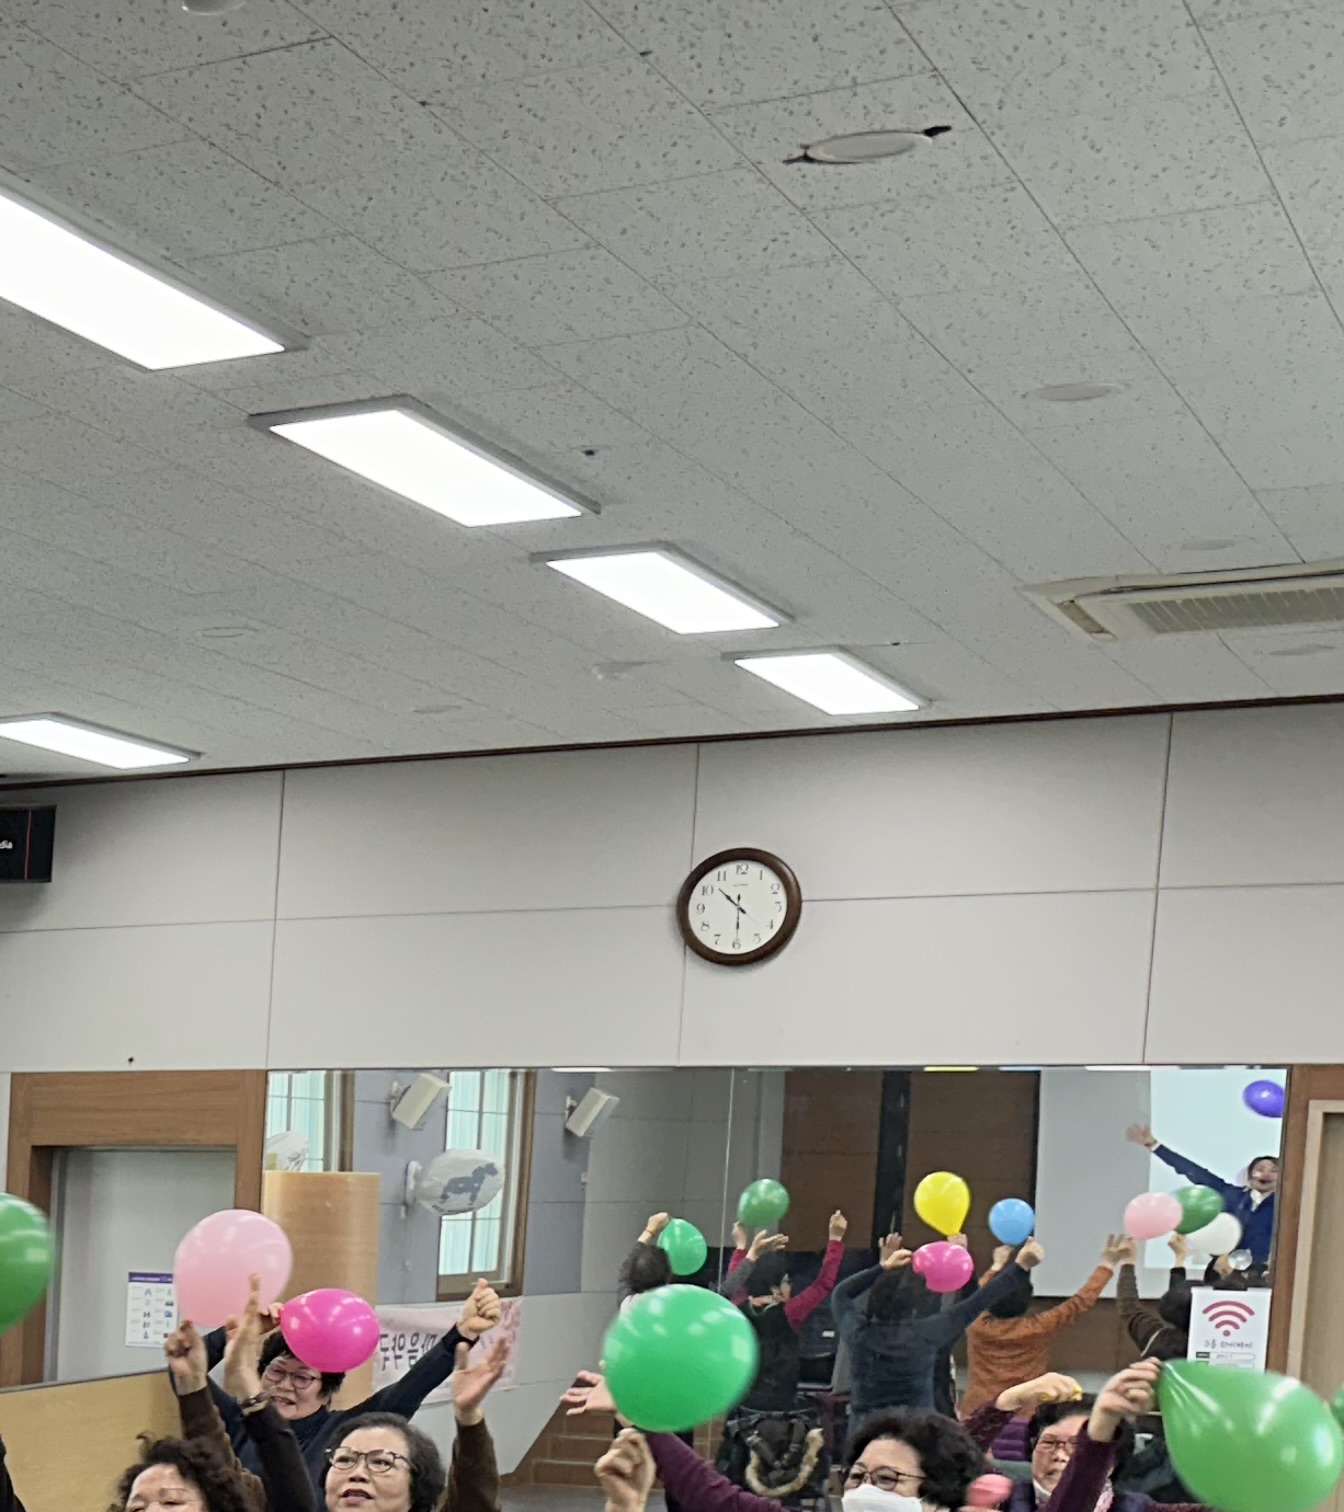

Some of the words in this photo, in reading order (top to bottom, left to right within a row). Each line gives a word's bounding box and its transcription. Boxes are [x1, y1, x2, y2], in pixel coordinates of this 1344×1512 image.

[717, 870, 727, 882] 11
[702, 885, 714, 896] 10
[696, 903, 706, 914] 9
